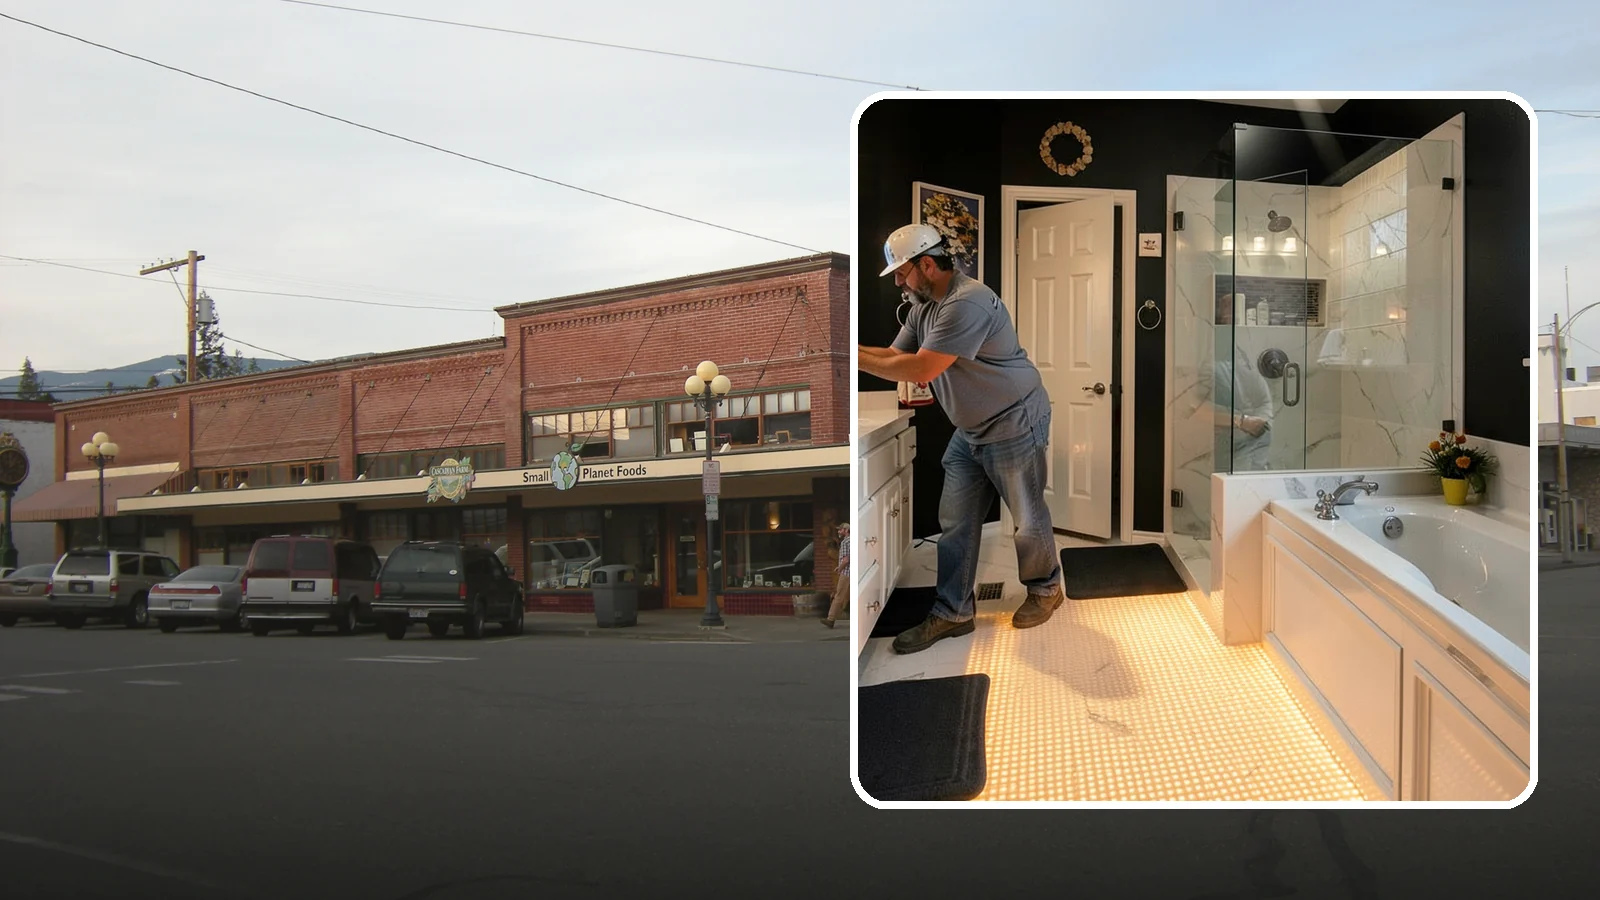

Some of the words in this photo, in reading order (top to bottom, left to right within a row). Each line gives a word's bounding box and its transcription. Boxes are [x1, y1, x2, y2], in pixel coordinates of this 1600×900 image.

[523, 471, 549, 483] Small
[583, 467, 614, 479] Planet
[617, 464, 647, 477] Foods
